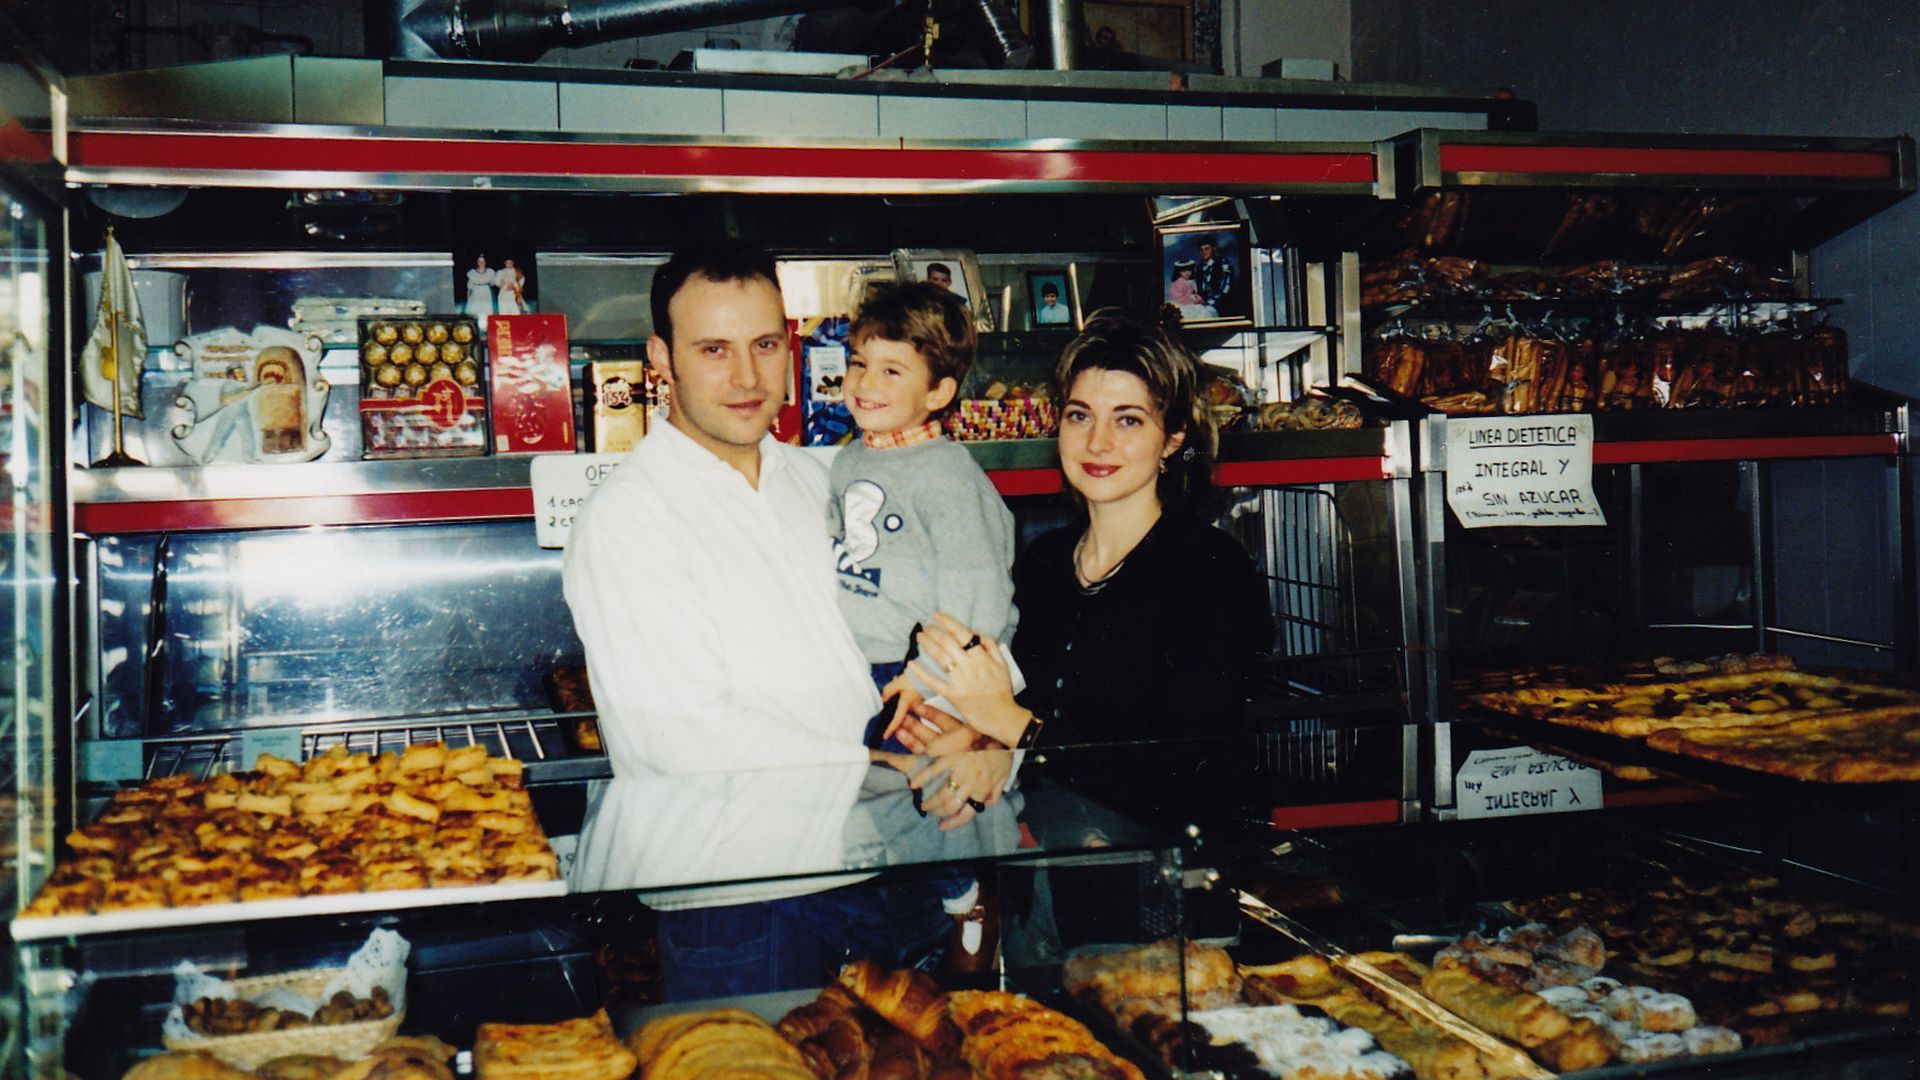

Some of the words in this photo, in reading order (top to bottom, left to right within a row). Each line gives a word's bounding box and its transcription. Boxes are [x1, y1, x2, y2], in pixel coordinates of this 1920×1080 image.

[1469, 428, 1501, 444] LINEA
[1507, 426, 1577, 443] DIETETICA
[1475, 460, 1548, 478] INTEGRAL
[1558, 459, 1570, 475] Y
[1482, 492, 1508, 506] SIN
[1519, 489, 1583, 504] AZUCAR
[549, 516, 556, 527] 2
